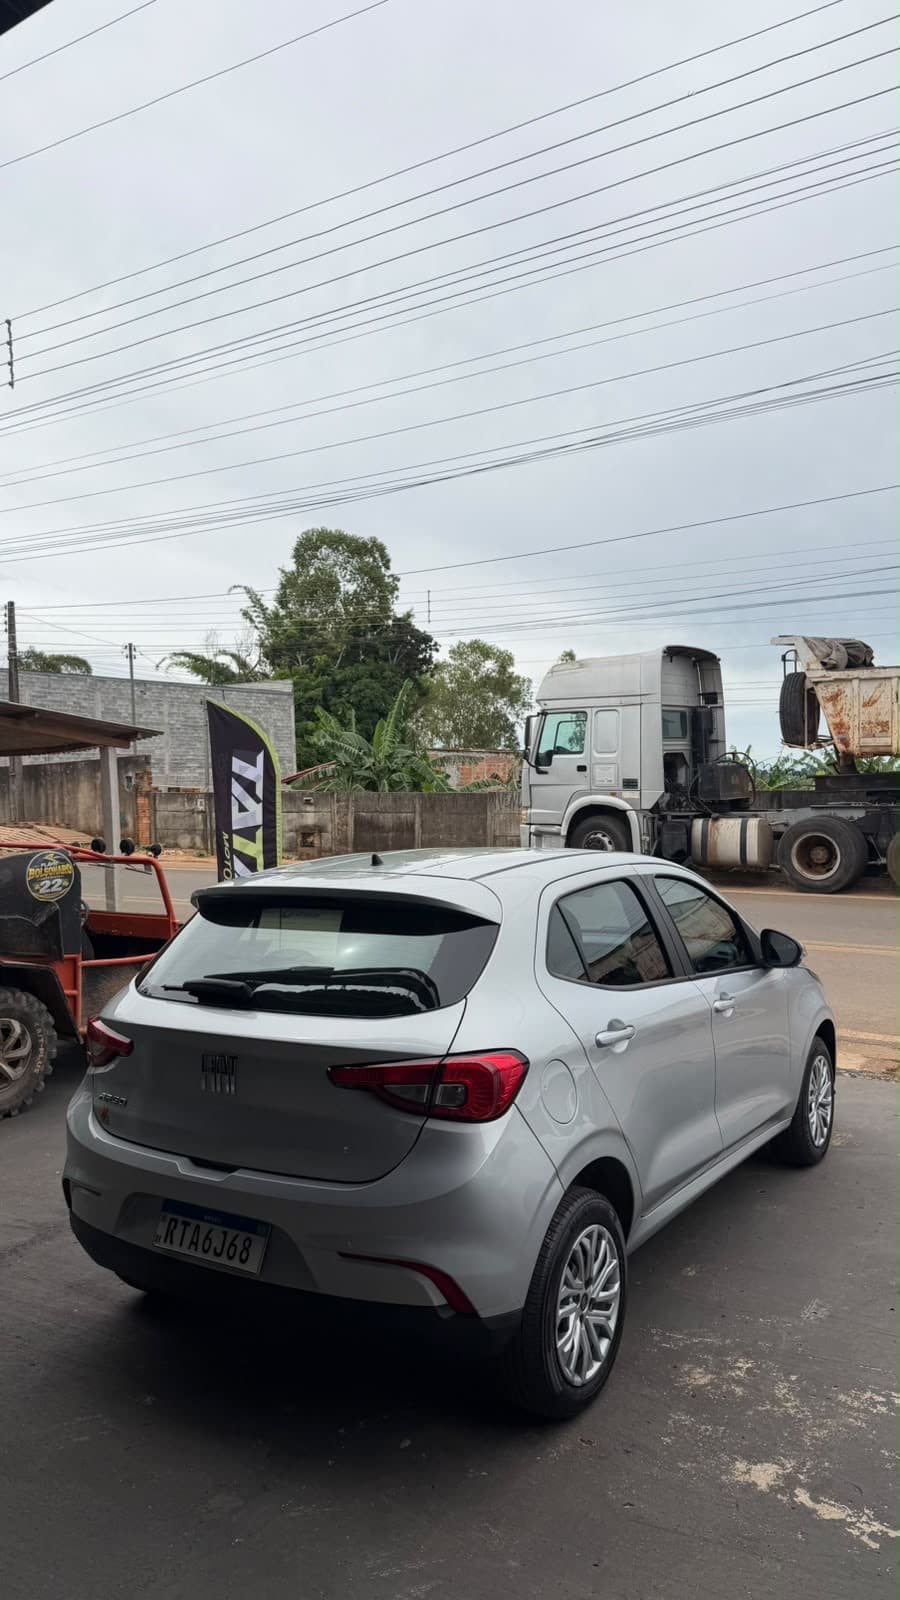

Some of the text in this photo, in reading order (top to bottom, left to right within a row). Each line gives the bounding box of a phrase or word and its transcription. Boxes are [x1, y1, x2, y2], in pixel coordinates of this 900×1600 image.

[222, 831, 233, 881] MOTO
[39, 879, 62, 894] 22
[163, 1217, 252, 1264] RTA6J68
